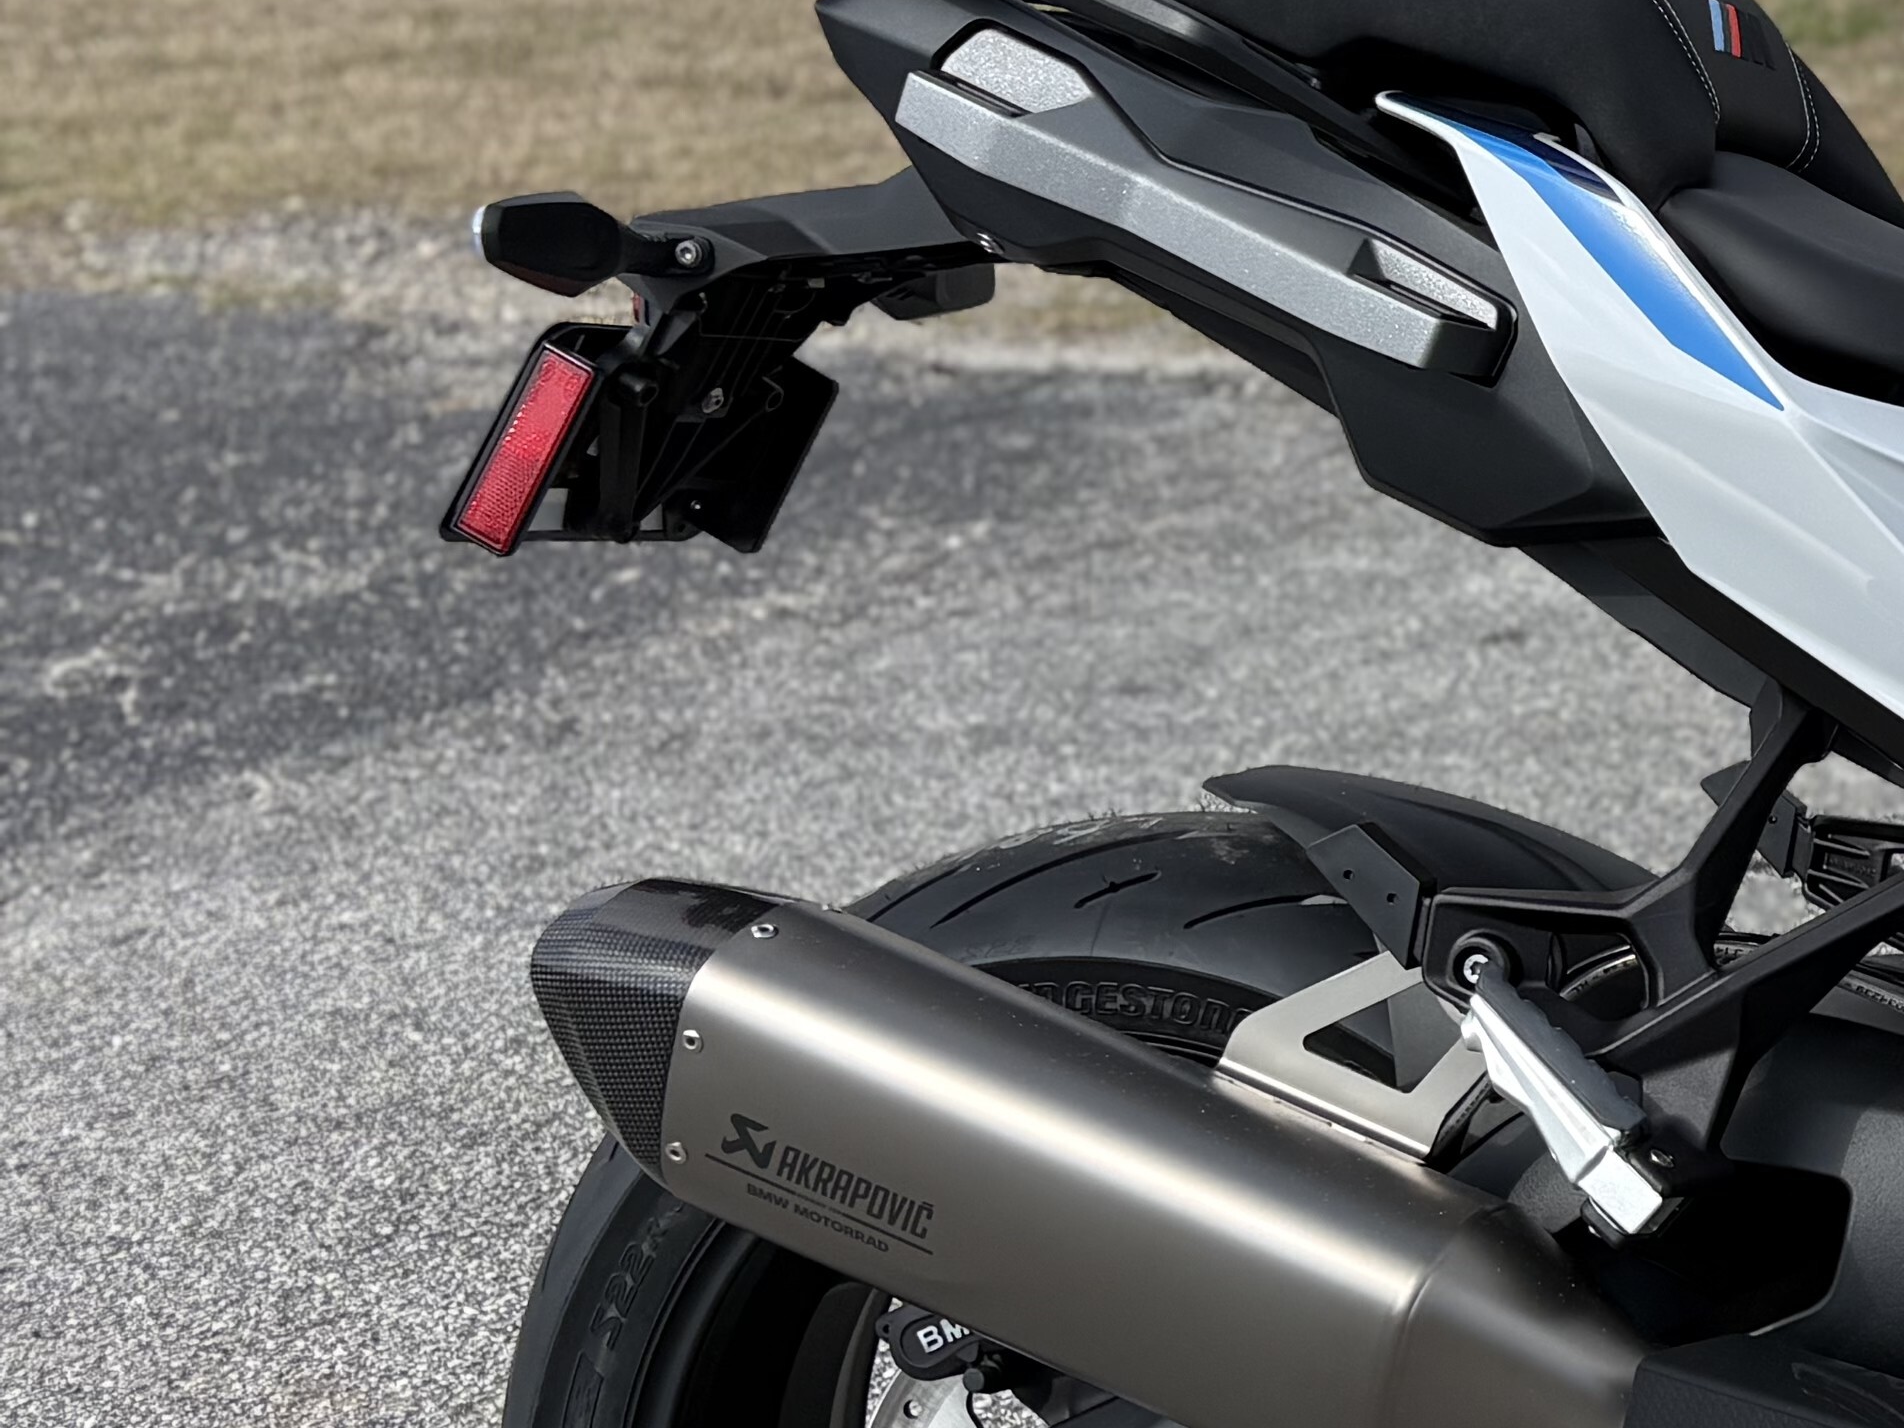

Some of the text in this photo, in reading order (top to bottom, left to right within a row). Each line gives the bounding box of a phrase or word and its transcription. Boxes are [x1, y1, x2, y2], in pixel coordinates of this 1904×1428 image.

[747, 1183, 790, 1212] BMW
[794, 1205, 889, 1253] MOTORRAD
[776, 1145, 935, 1240] AKRAPOVIČ
